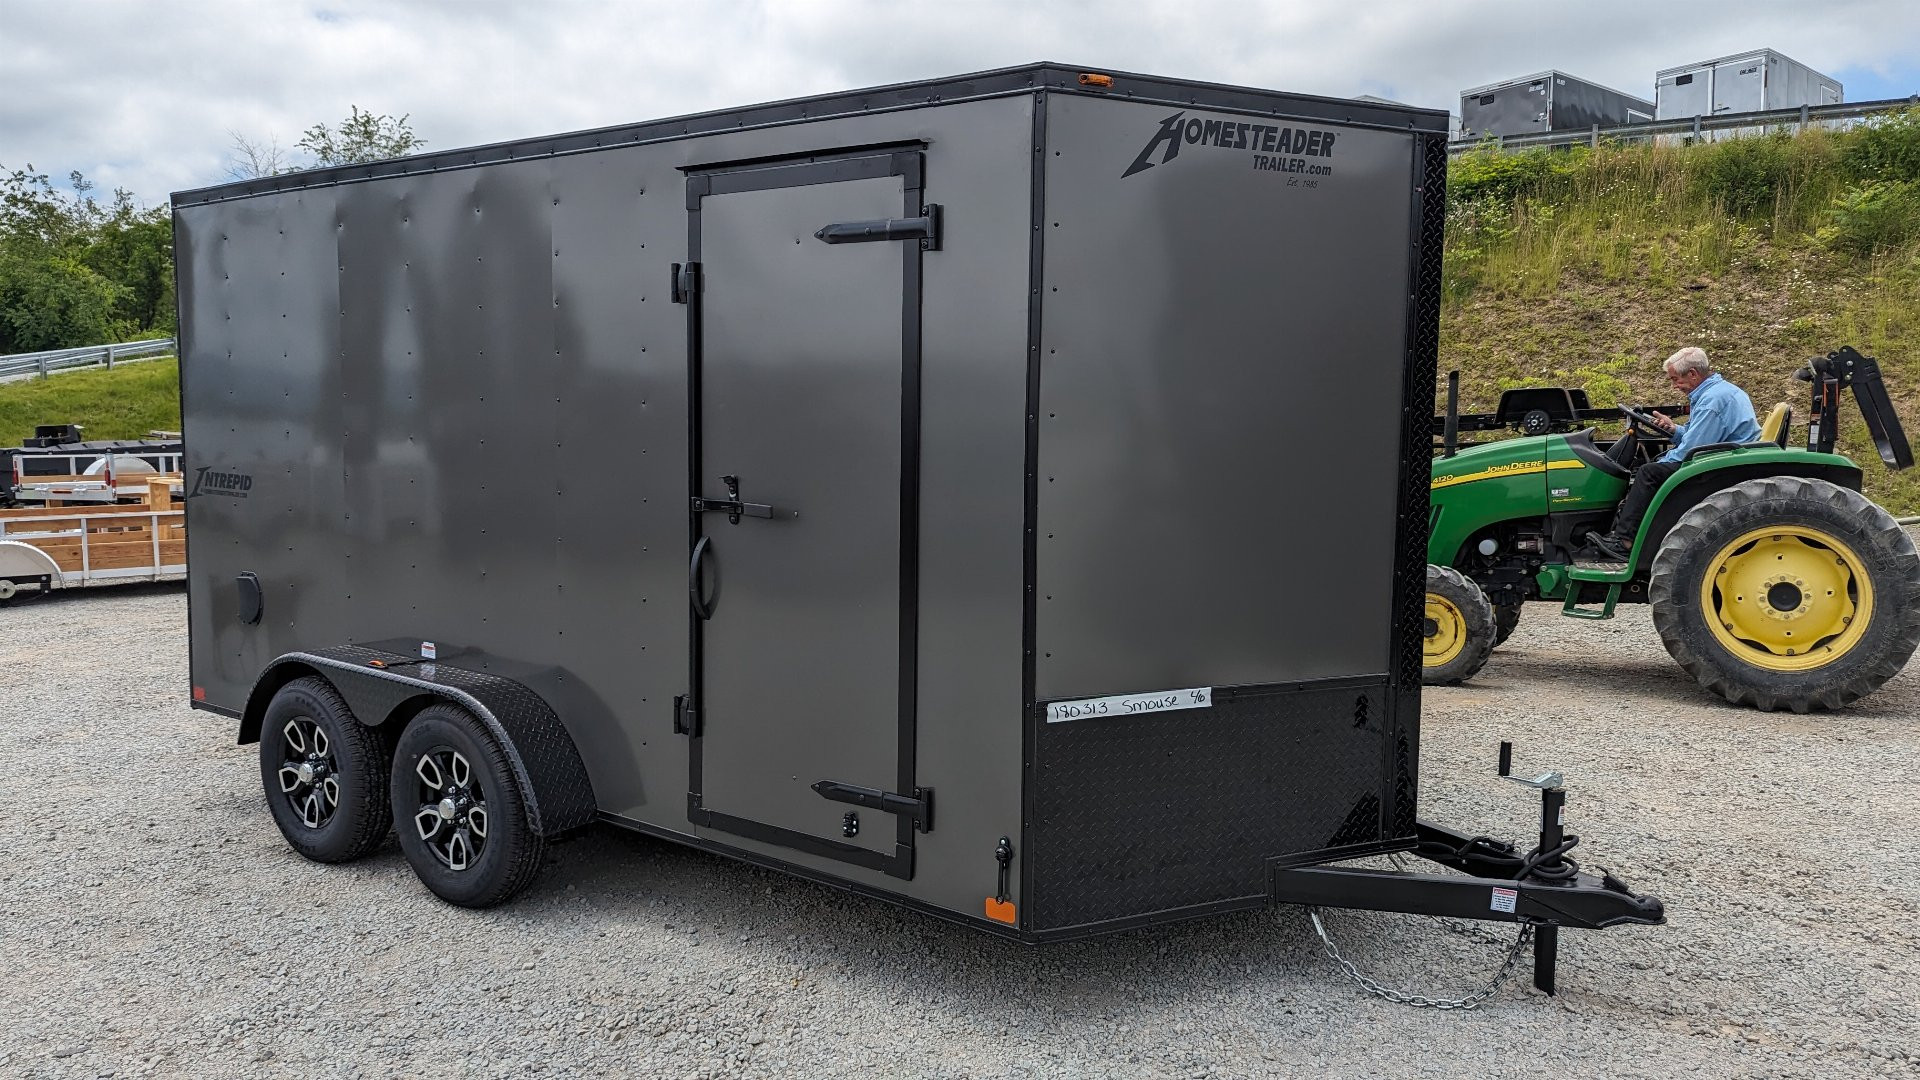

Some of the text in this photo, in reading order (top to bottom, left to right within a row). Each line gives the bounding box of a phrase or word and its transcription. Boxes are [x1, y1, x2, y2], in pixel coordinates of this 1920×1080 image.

[1120, 111, 1335, 179] HOMESTEADER
[1252, 154, 1332, 177] TRAILER.com
[1485, 460, 1543, 474] JOHN DEERE
[189, 465, 253, 499] INTREPID
[1432, 474, 1454, 484] 4120
[1054, 701, 1108, 719] 180313
